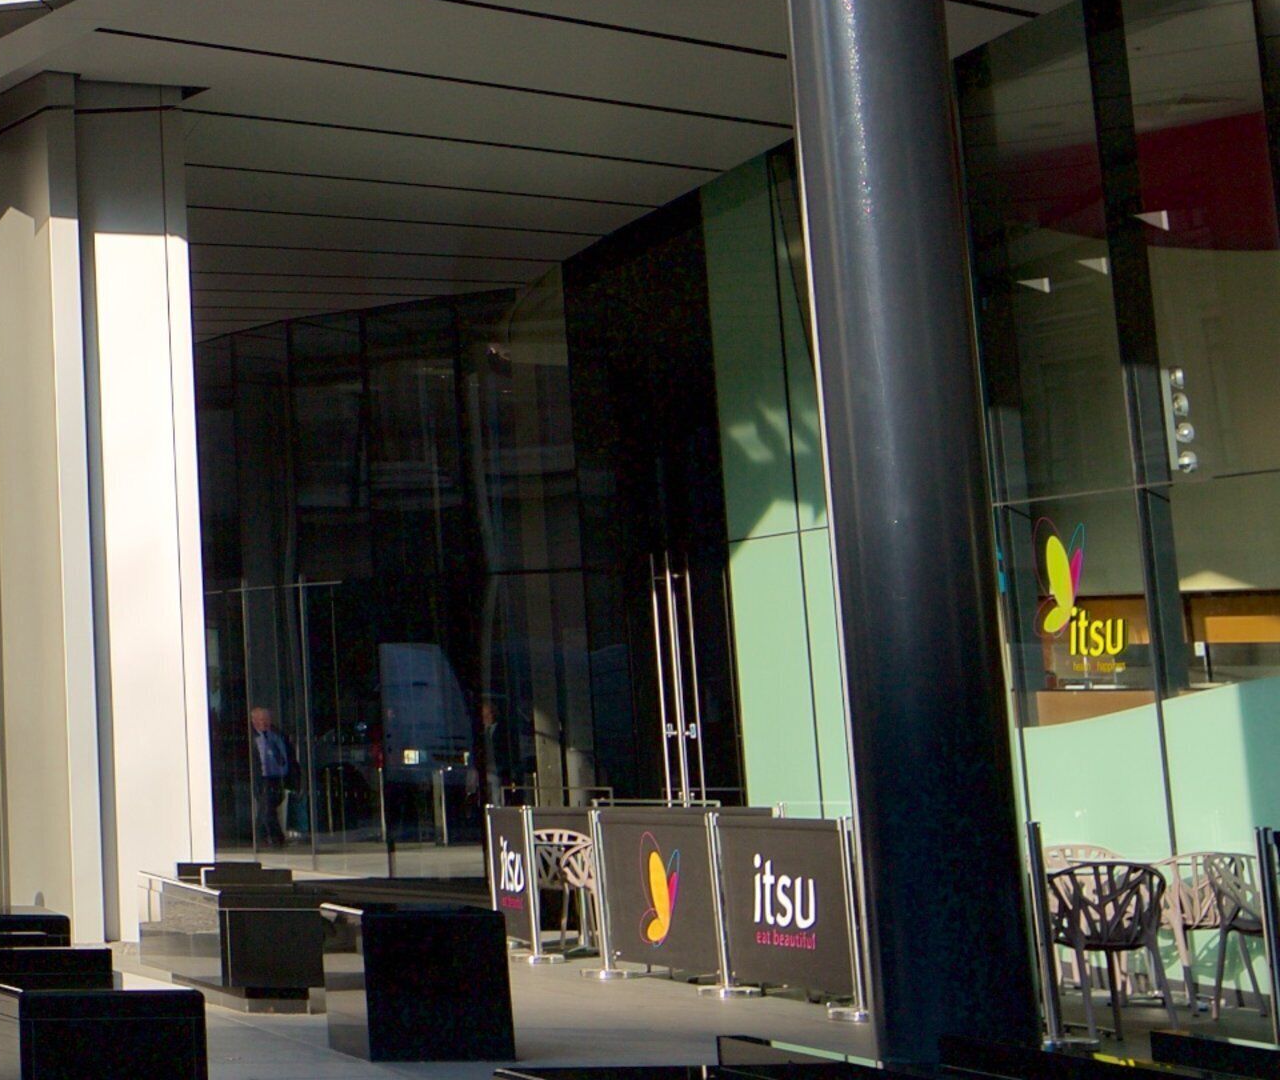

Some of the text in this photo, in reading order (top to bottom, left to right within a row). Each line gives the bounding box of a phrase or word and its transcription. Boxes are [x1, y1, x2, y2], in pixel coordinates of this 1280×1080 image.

[1070, 606, 1124, 657] itsu
[500, 835, 524, 893] itsu
[754, 853, 816, 929] itsu
[756, 928, 816, 951] eat beautiful
